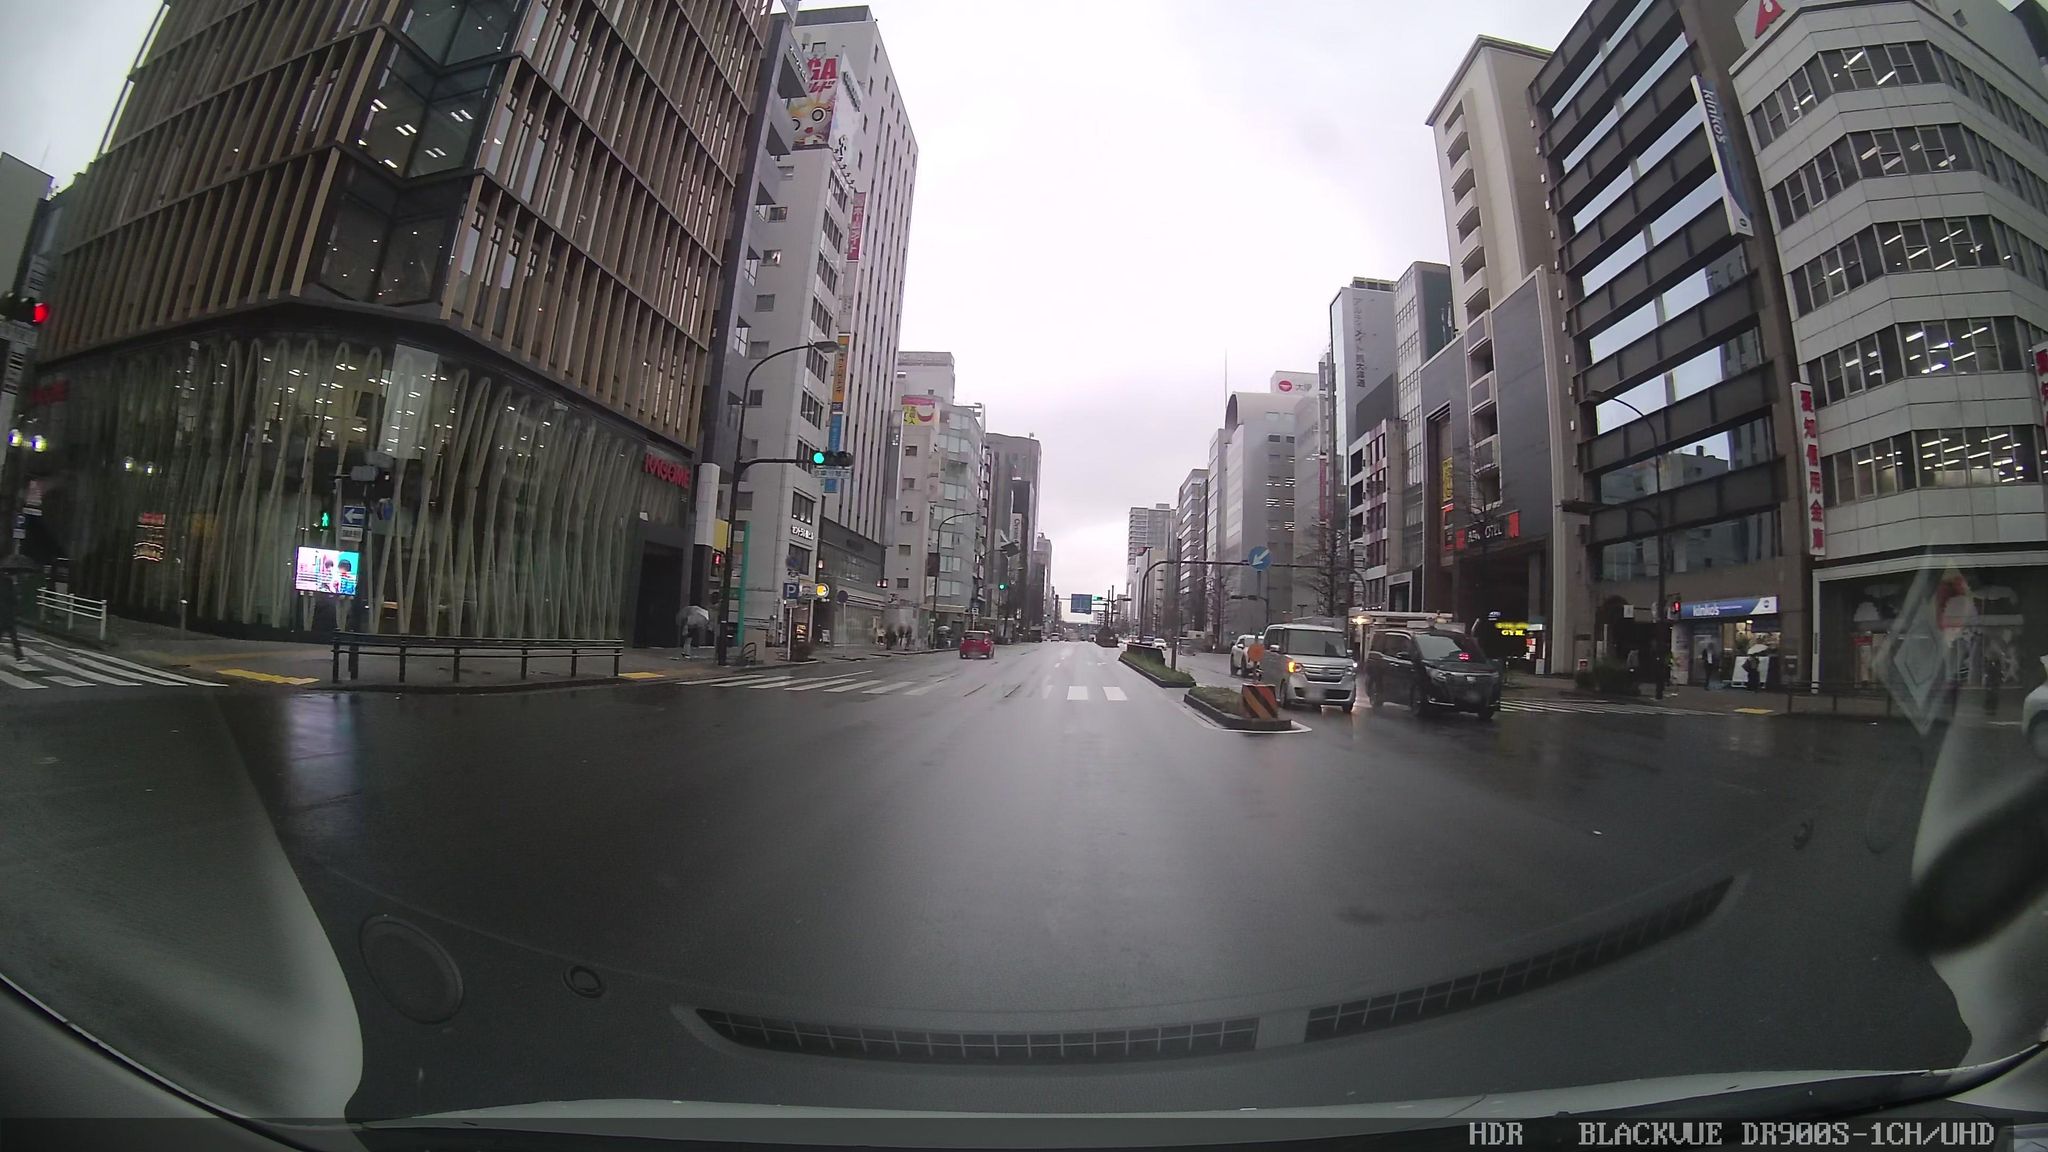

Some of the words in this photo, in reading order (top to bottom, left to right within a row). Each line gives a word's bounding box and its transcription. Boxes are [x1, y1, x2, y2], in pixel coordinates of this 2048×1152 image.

[644, 452, 689, 489] KAGOME
[1799, 389, 1825, 551] 愛知信用金庫
